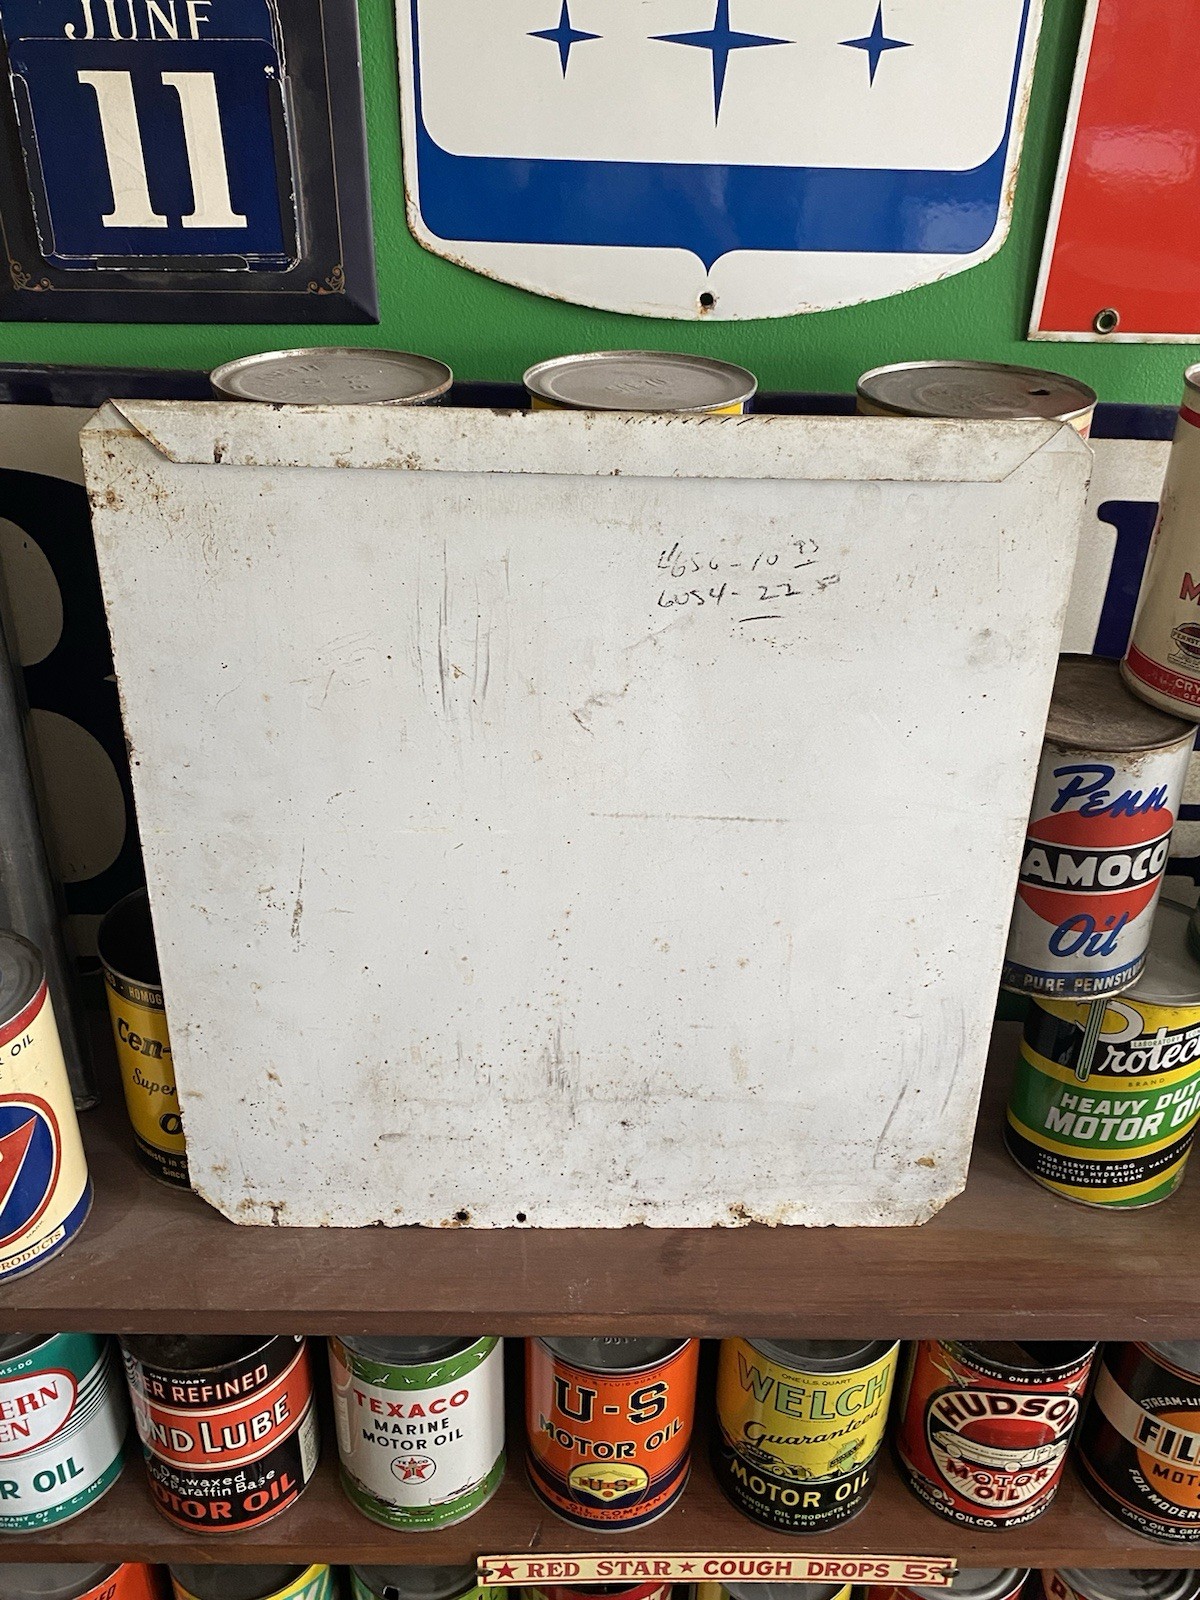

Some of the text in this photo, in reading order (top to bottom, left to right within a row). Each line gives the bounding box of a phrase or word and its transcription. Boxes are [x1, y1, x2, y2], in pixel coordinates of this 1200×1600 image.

[77, 70, 248, 229] 11
[1020, 838, 1170, 888] AMOCO
[1048, 912, 1130, 958] Oil
[1023, 973, 1066, 992] PURE
[11, 1033, 34, 1058] OIL
[117, 1017, 173, 1060] Cen-
[1132, 1036, 1181, 1048] LABORATORY
[132, 1067, 177, 1096] Super
[1127, 1077, 1166, 1088] BRAND
[1059, 1092, 1150, 1117] HEAVY
[1043, 1105, 1166, 1142] MOTOR
[1062, 1160, 1101, 1171] SERVICE
[1070, 1176, 1108, 1184] ENGINE
[1112, 1173, 1143, 1184] CLEAN
[1089, 1166, 1145, 1177] HYDRAULIC
[0, 1230, 62, 1271] RODUCTS
[171, 1363, 269, 1403] REFINED
[781, 1373, 801, 1383] ONE
[821, 1377, 852, 1386] QUART
[956, 1354, 1003, 1379] CONTENTS
[1008, 1375, 1030, 1384] ONE
[553, 1375, 670, 1425] U-S
[737, 1350, 891, 1421] WELCH
[352, 1389, 470, 1419] TEXACO
[935, 1392, 1077, 1433] HUDSON
[198, 1392, 291, 1454] LUBE
[373, 1417, 450, 1435] MARINE
[539, 1412, 685, 1460] MOTOR OIL
[743, 1400, 883, 1449] Guaranteed
[362, 1428, 464, 1451] MOTOR OIL
[1133, 1412, 1200, 1464] FIL
[33, 1457, 84, 1494] OIL
[160, 1464, 247, 1487] De-waxed
[235, 1469, 276, 1494] Base
[730, 1458, 870, 1508] MOTOR OIL
[945, 1456, 1049, 1488] MOTOR
[1128, 1468, 1149, 1493] FOR
[1152, 1462, 1200, 1487] MOT
[243, 1472, 296, 1512] OIL
[568, 1491, 668, 1517] OIL COMPANY
[734, 1485, 770, 1512] ILLINOIS
[774, 1509, 791, 1518] OIL
[793, 1505, 844, 1521] PRODUCTS
[910, 1478, 955, 1517] HUDSON
[955, 1512, 975, 1525] OIL
[975, 1517, 998, 1528] CO.
[973, 1485, 1021, 1502] OIL
[35, 1511, 49, 1519] OF
[773, 1515, 816, 1526] ISLAND
[1121, 1507, 1147, 1525] CATO
[1148, 1522, 1166, 1532] OIL
[1142, 1525, 1186, 1539] OKLAHOMA
[526, 1561, 581, 1578] RED
[596, 1560, 673, 1577] STAR
[703, 1559, 792, 1576] COUGH
[806, 1560, 890, 1578] DROPS
